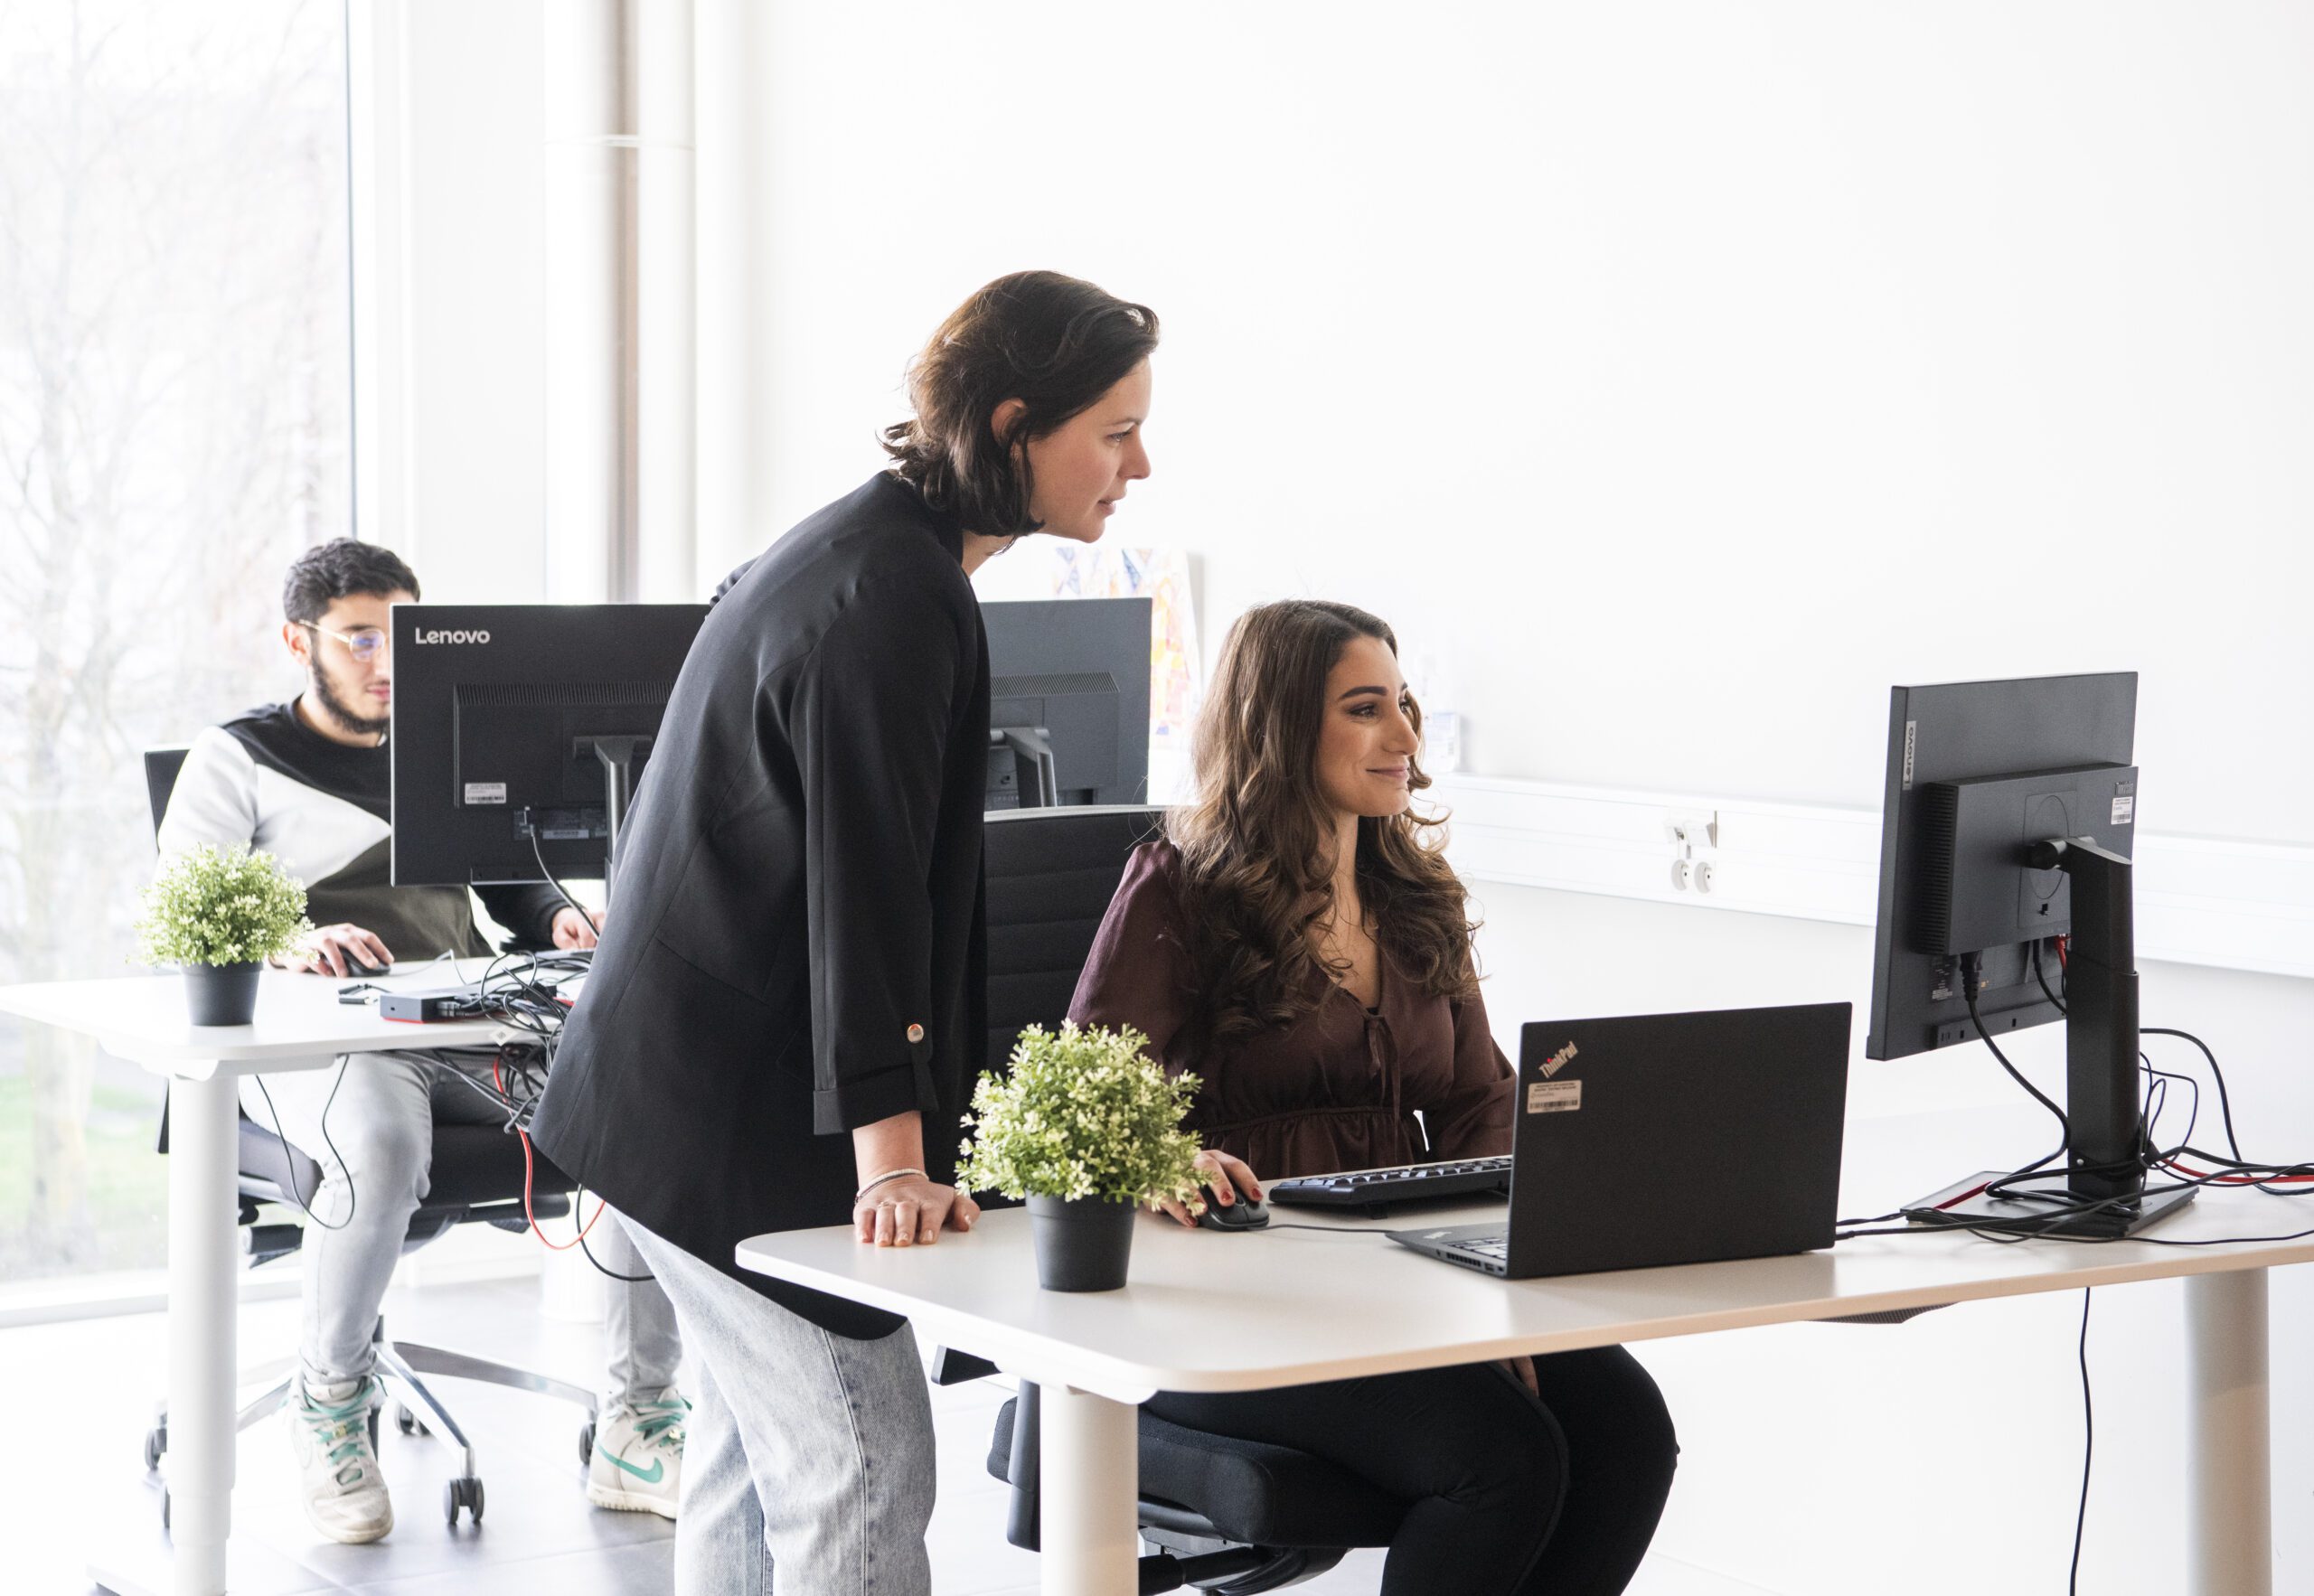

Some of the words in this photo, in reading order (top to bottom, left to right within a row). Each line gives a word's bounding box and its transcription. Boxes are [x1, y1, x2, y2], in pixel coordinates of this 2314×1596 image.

[416, 627, 490, 644] Lenovo
[1904, 727, 1914, 784] Lenovo
[1538, 1040, 1578, 1078] ThinkPad
